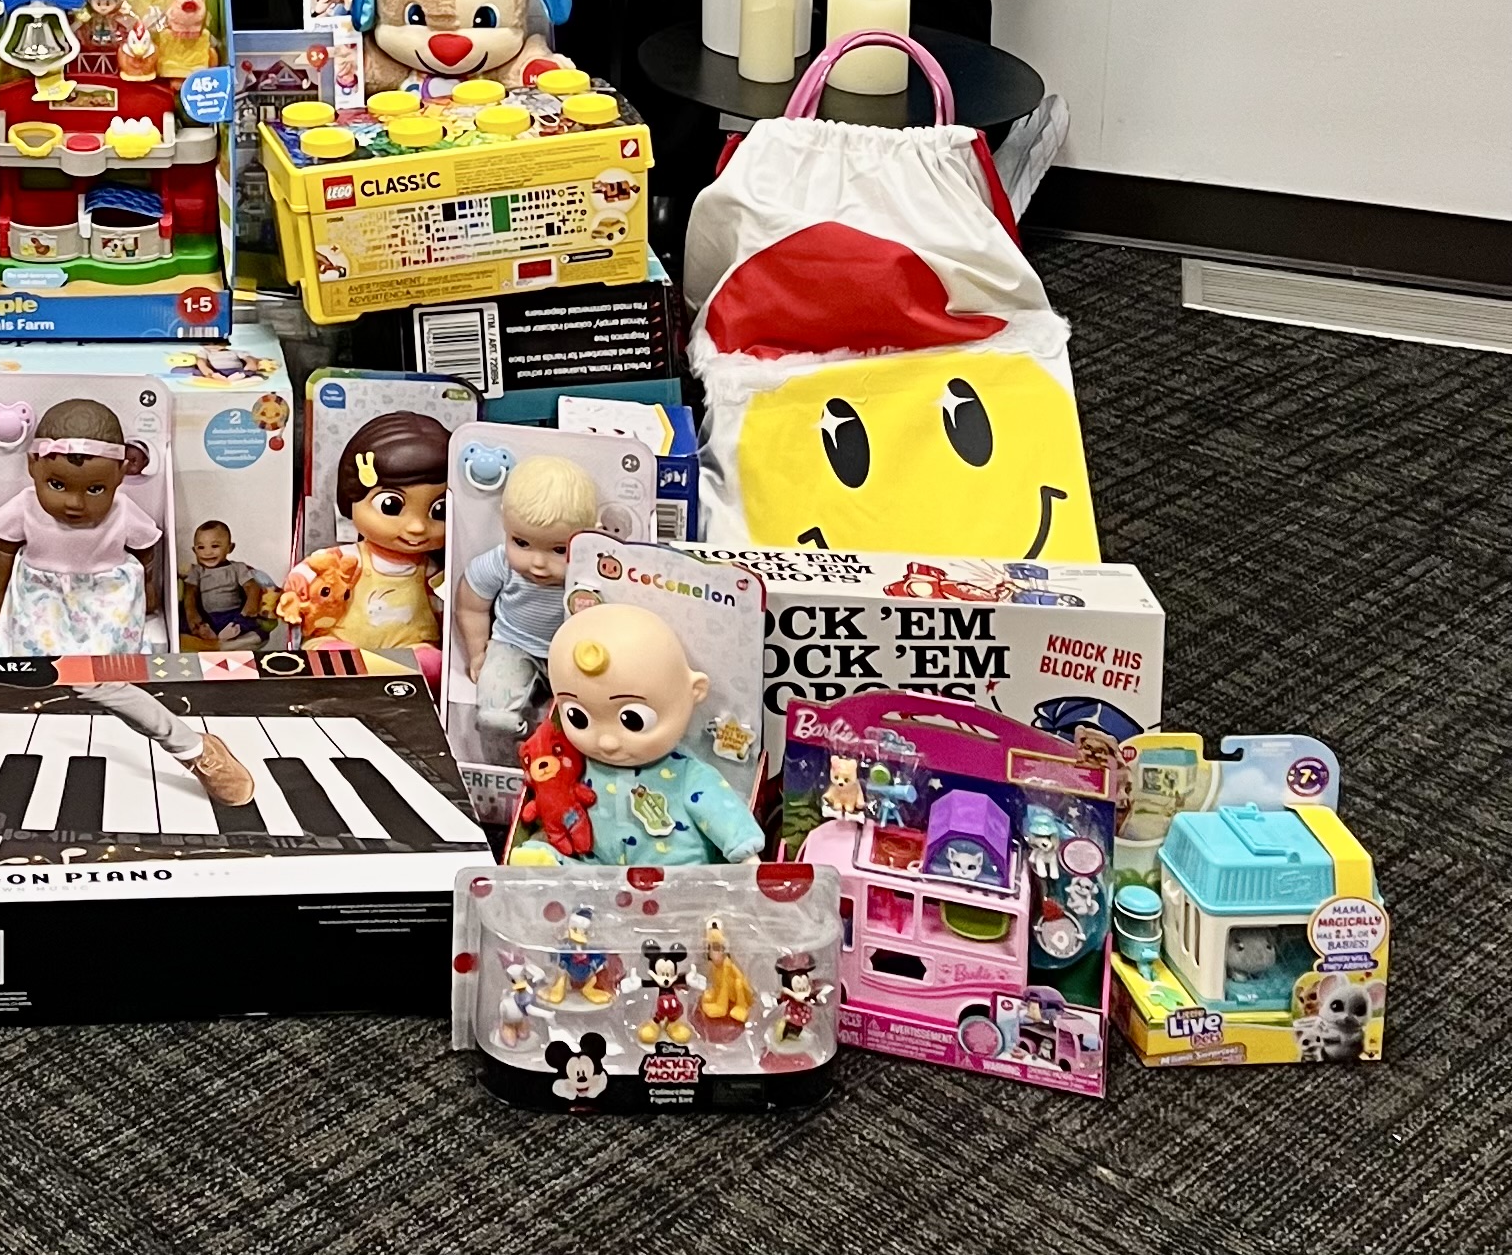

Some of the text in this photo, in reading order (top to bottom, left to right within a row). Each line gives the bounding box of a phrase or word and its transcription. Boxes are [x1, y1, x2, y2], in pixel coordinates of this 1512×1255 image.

[191, 77, 220, 93] 45+
[325, 183, 354, 201] LEGO
[360, 171, 442, 198] CLASSIC
[182, 296, 213, 314] 1-5
[17, 319, 56, 332] Farm
[229, 410, 242, 425] 2
[1046, 633, 1143, 670] KNOCK HIS
[1039, 655, 1141, 694] BLOCK OFF!
[793, 708, 860, 744] Barbie
[65, 868, 175, 884] PIANO
[1331, 904, 1367, 916] MAMA
[1317, 915, 1382, 930] MAGICALLY
[1327, 938, 1371, 951] BABIES!
[1168, 1014, 1222, 1038] Live
[644, 1056, 702, 1072] MICKEY
[645, 1068, 700, 1084] MOUSE
